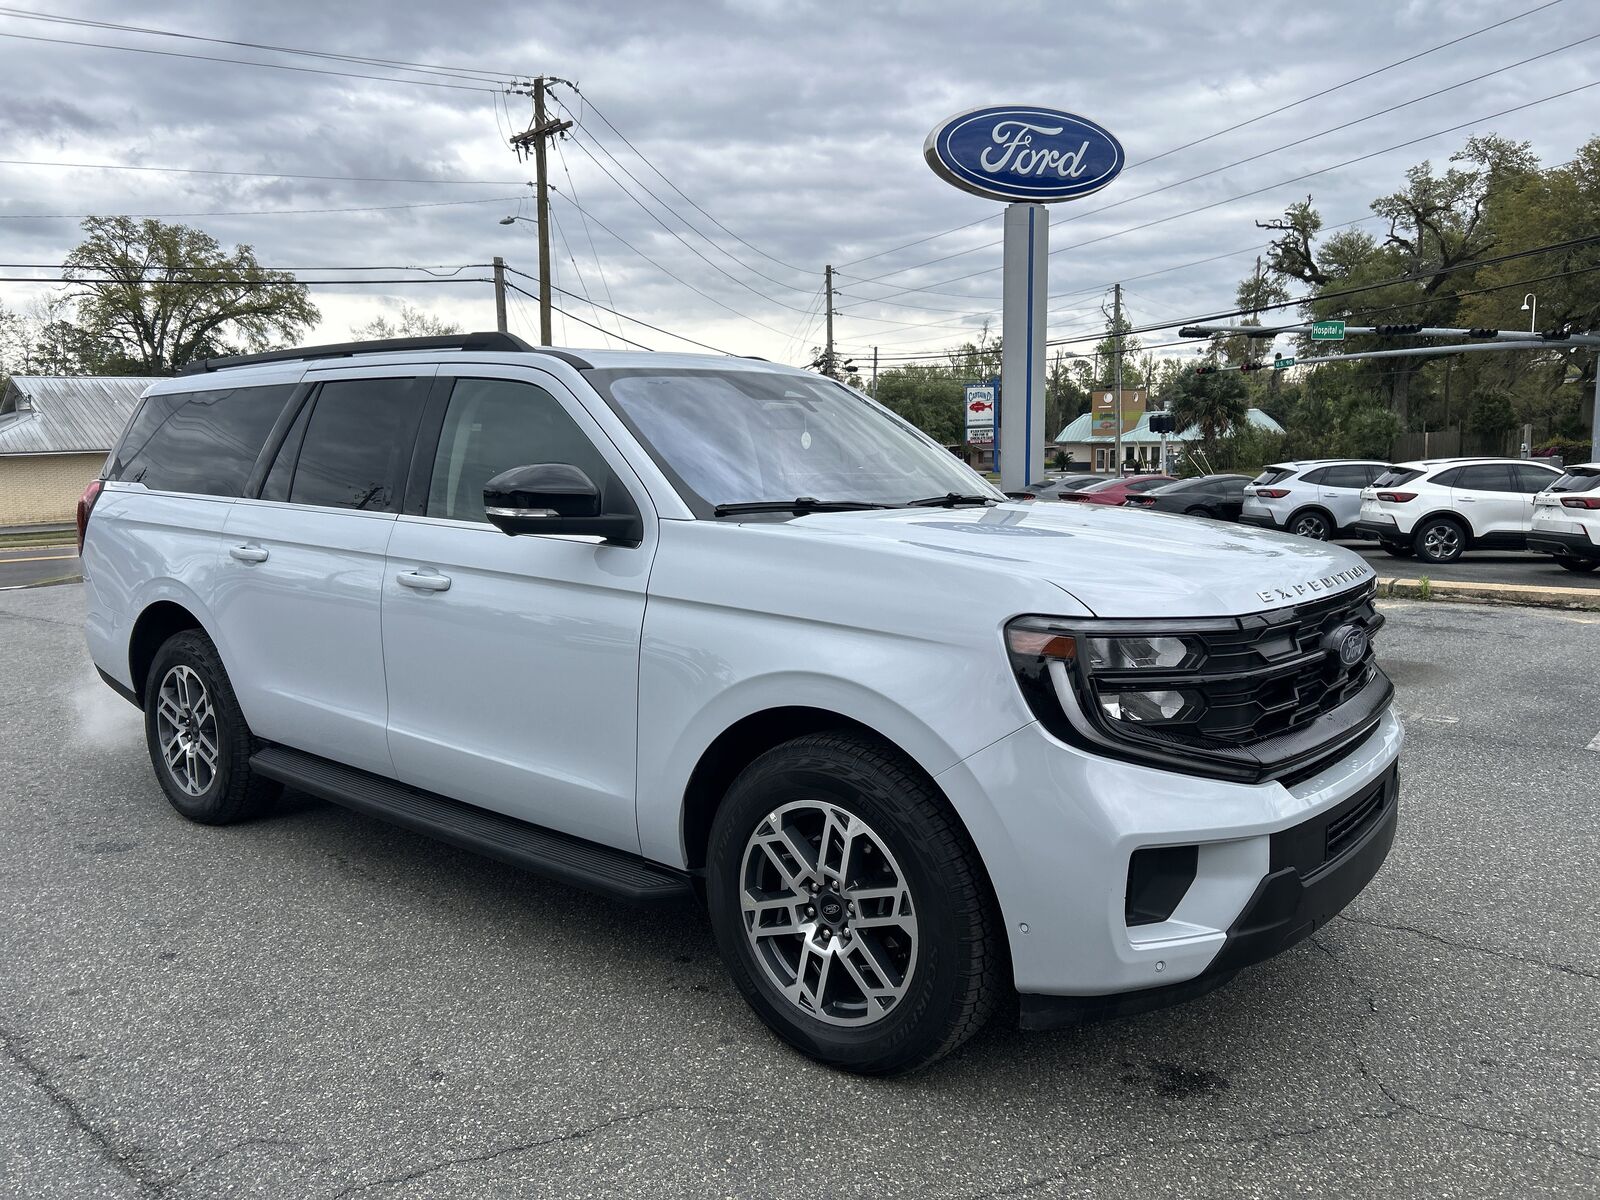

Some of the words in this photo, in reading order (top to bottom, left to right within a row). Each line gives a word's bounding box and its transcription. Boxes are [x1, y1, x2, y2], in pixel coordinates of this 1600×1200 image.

[980, 121, 1090, 178] Ford
[1313, 325, 1337, 336] Hospital
[1256, 565, 1367, 603] EXPEDITION
